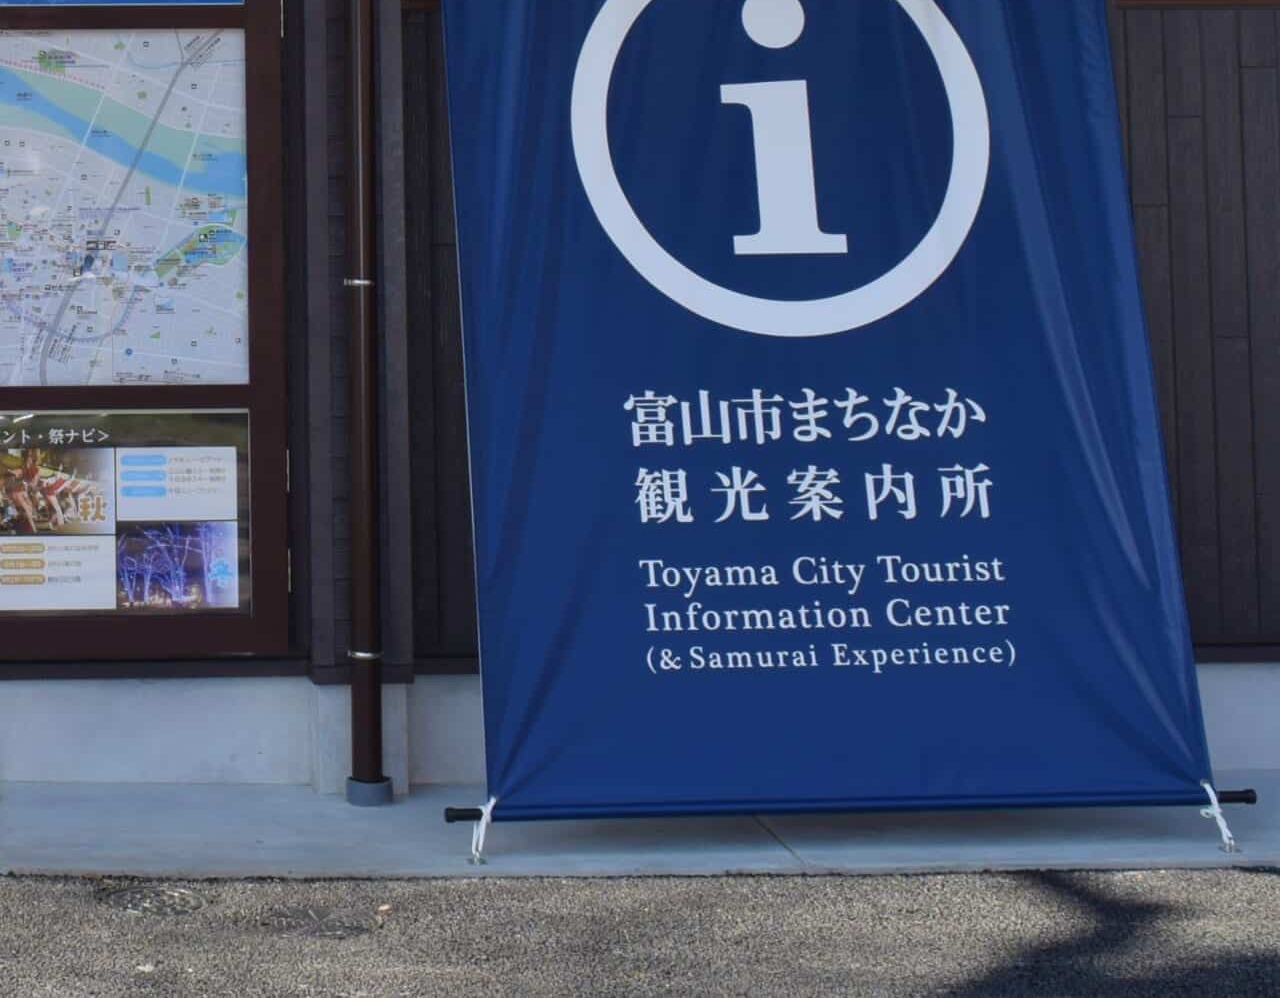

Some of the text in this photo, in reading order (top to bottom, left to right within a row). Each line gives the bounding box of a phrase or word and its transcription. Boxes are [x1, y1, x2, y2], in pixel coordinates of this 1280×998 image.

[624, 387, 986, 447] 富山市まちなか
[634, 463, 993, 523] 観光案内所
[639, 553, 1006, 599] Toyama City Tourist
[644, 598, 1011, 633] Information Center
[690, 644, 820, 670] Samurai
[831, 639, 1017, 674] Experience)
